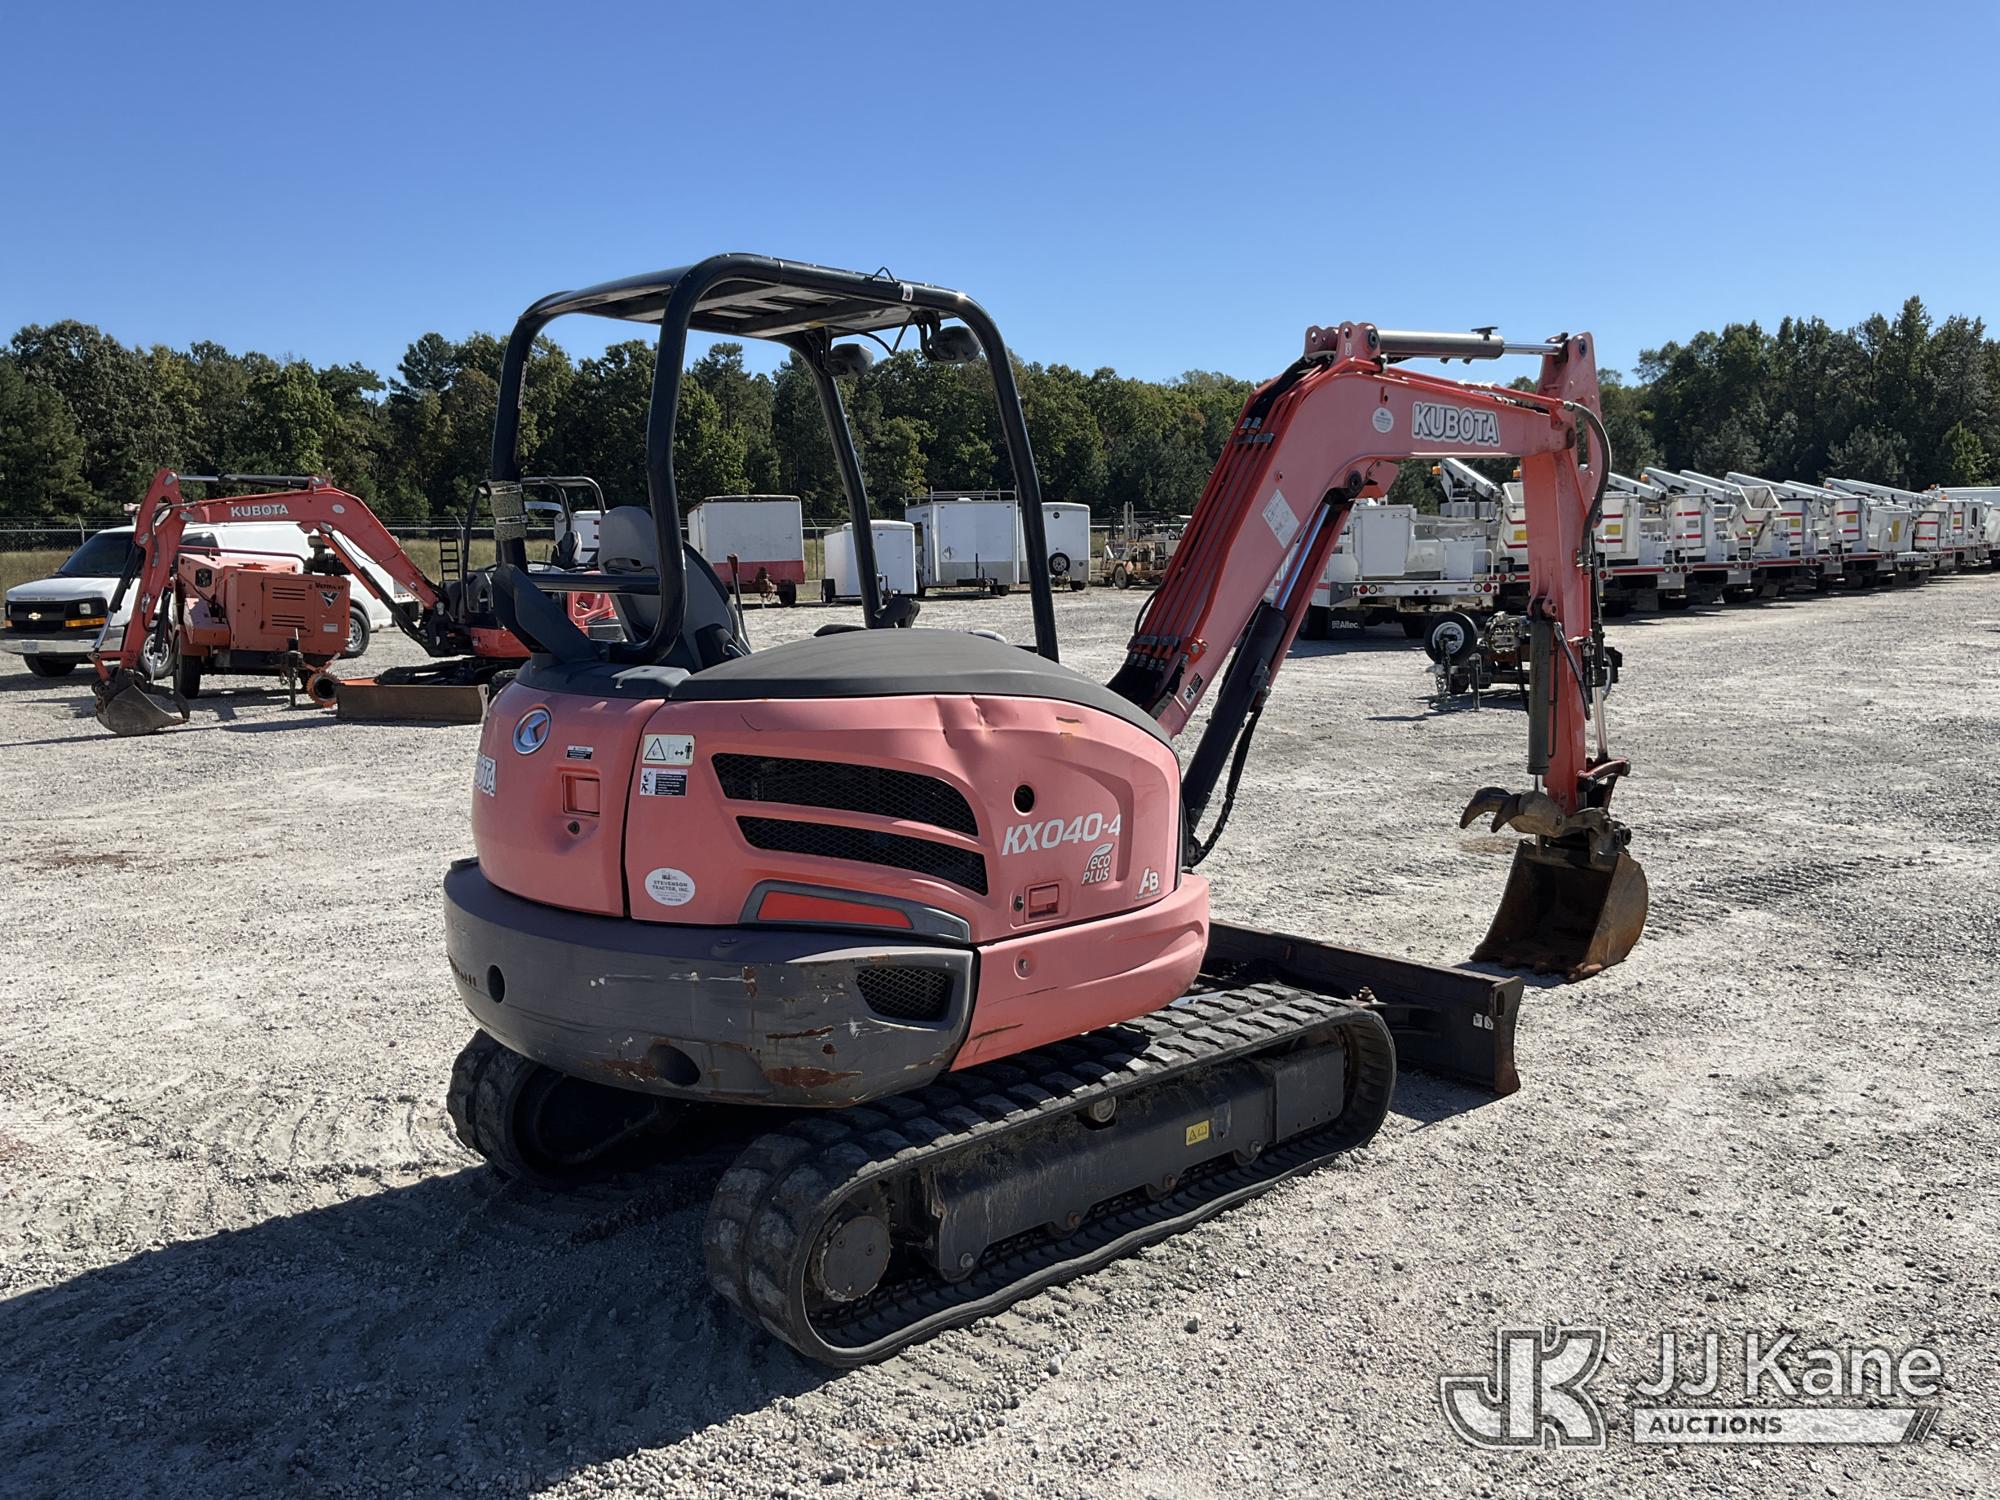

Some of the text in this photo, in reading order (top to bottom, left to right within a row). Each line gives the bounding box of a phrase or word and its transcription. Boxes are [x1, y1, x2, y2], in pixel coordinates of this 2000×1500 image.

[1413, 402, 1499, 444] KUBOTA
[231, 504, 289, 518] KUBOTA
[1002, 813, 1121, 856] KX040-4
[1089, 854, 1111, 870] eco
[653, 879, 688, 887] STEVENSON
[1081, 867, 1110, 885] PLUS
